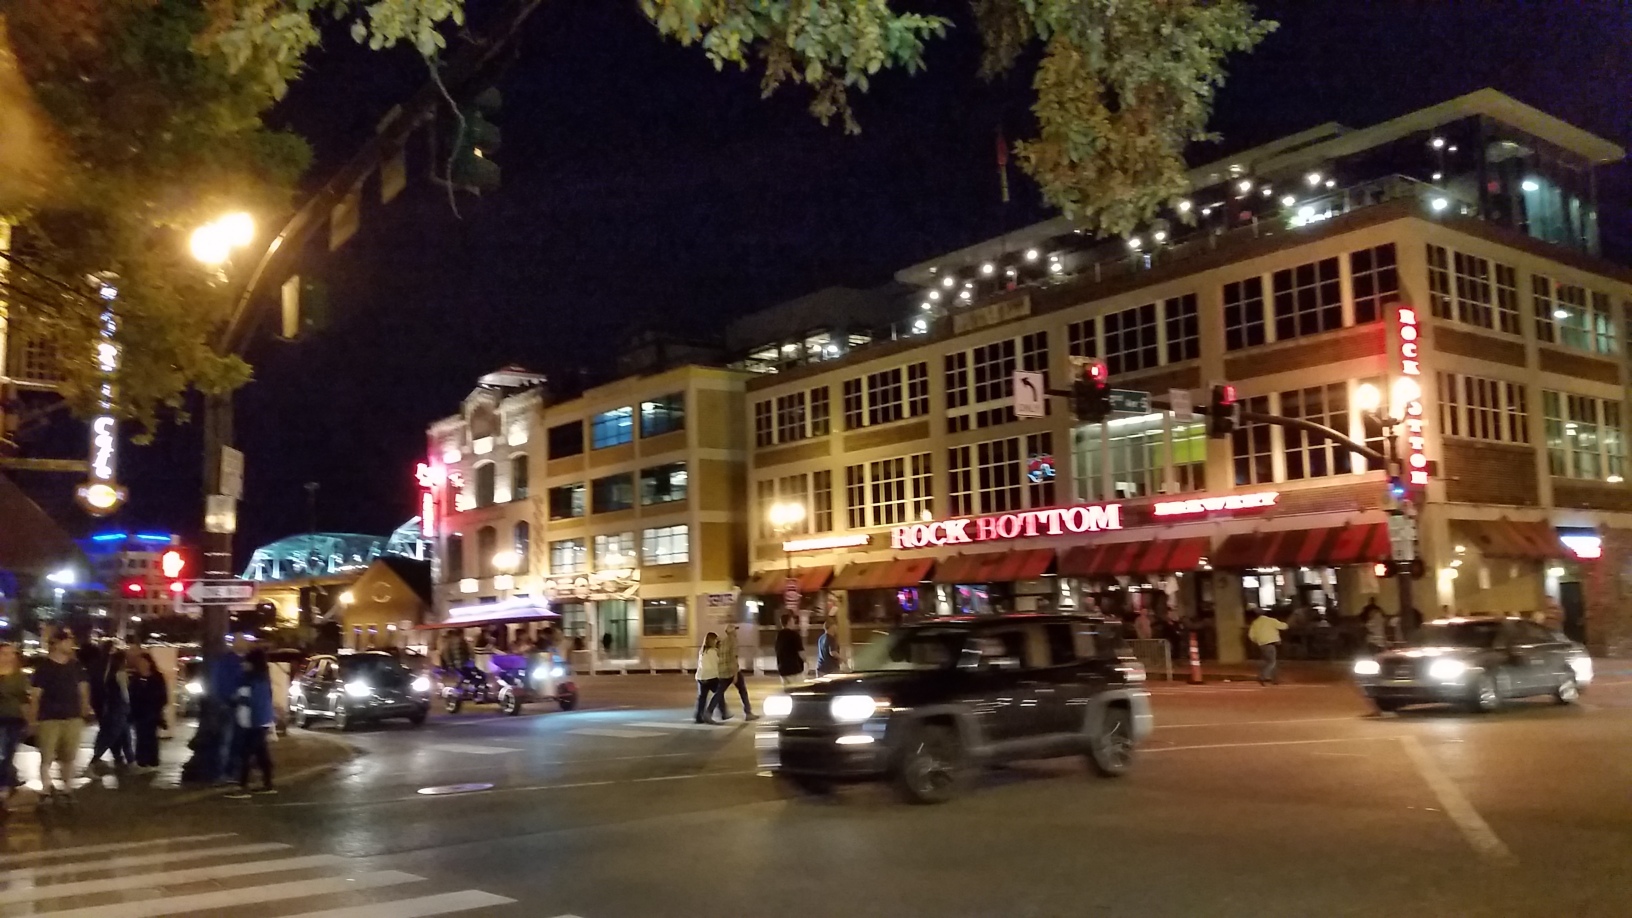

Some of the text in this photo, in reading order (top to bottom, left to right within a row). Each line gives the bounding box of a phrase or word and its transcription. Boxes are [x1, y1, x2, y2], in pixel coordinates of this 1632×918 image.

[1398, 308, 1429, 485] ROCK OTTOM
[890, 518, 973, 549] ROCK
[974, 503, 1124, 541] BOTTOM
